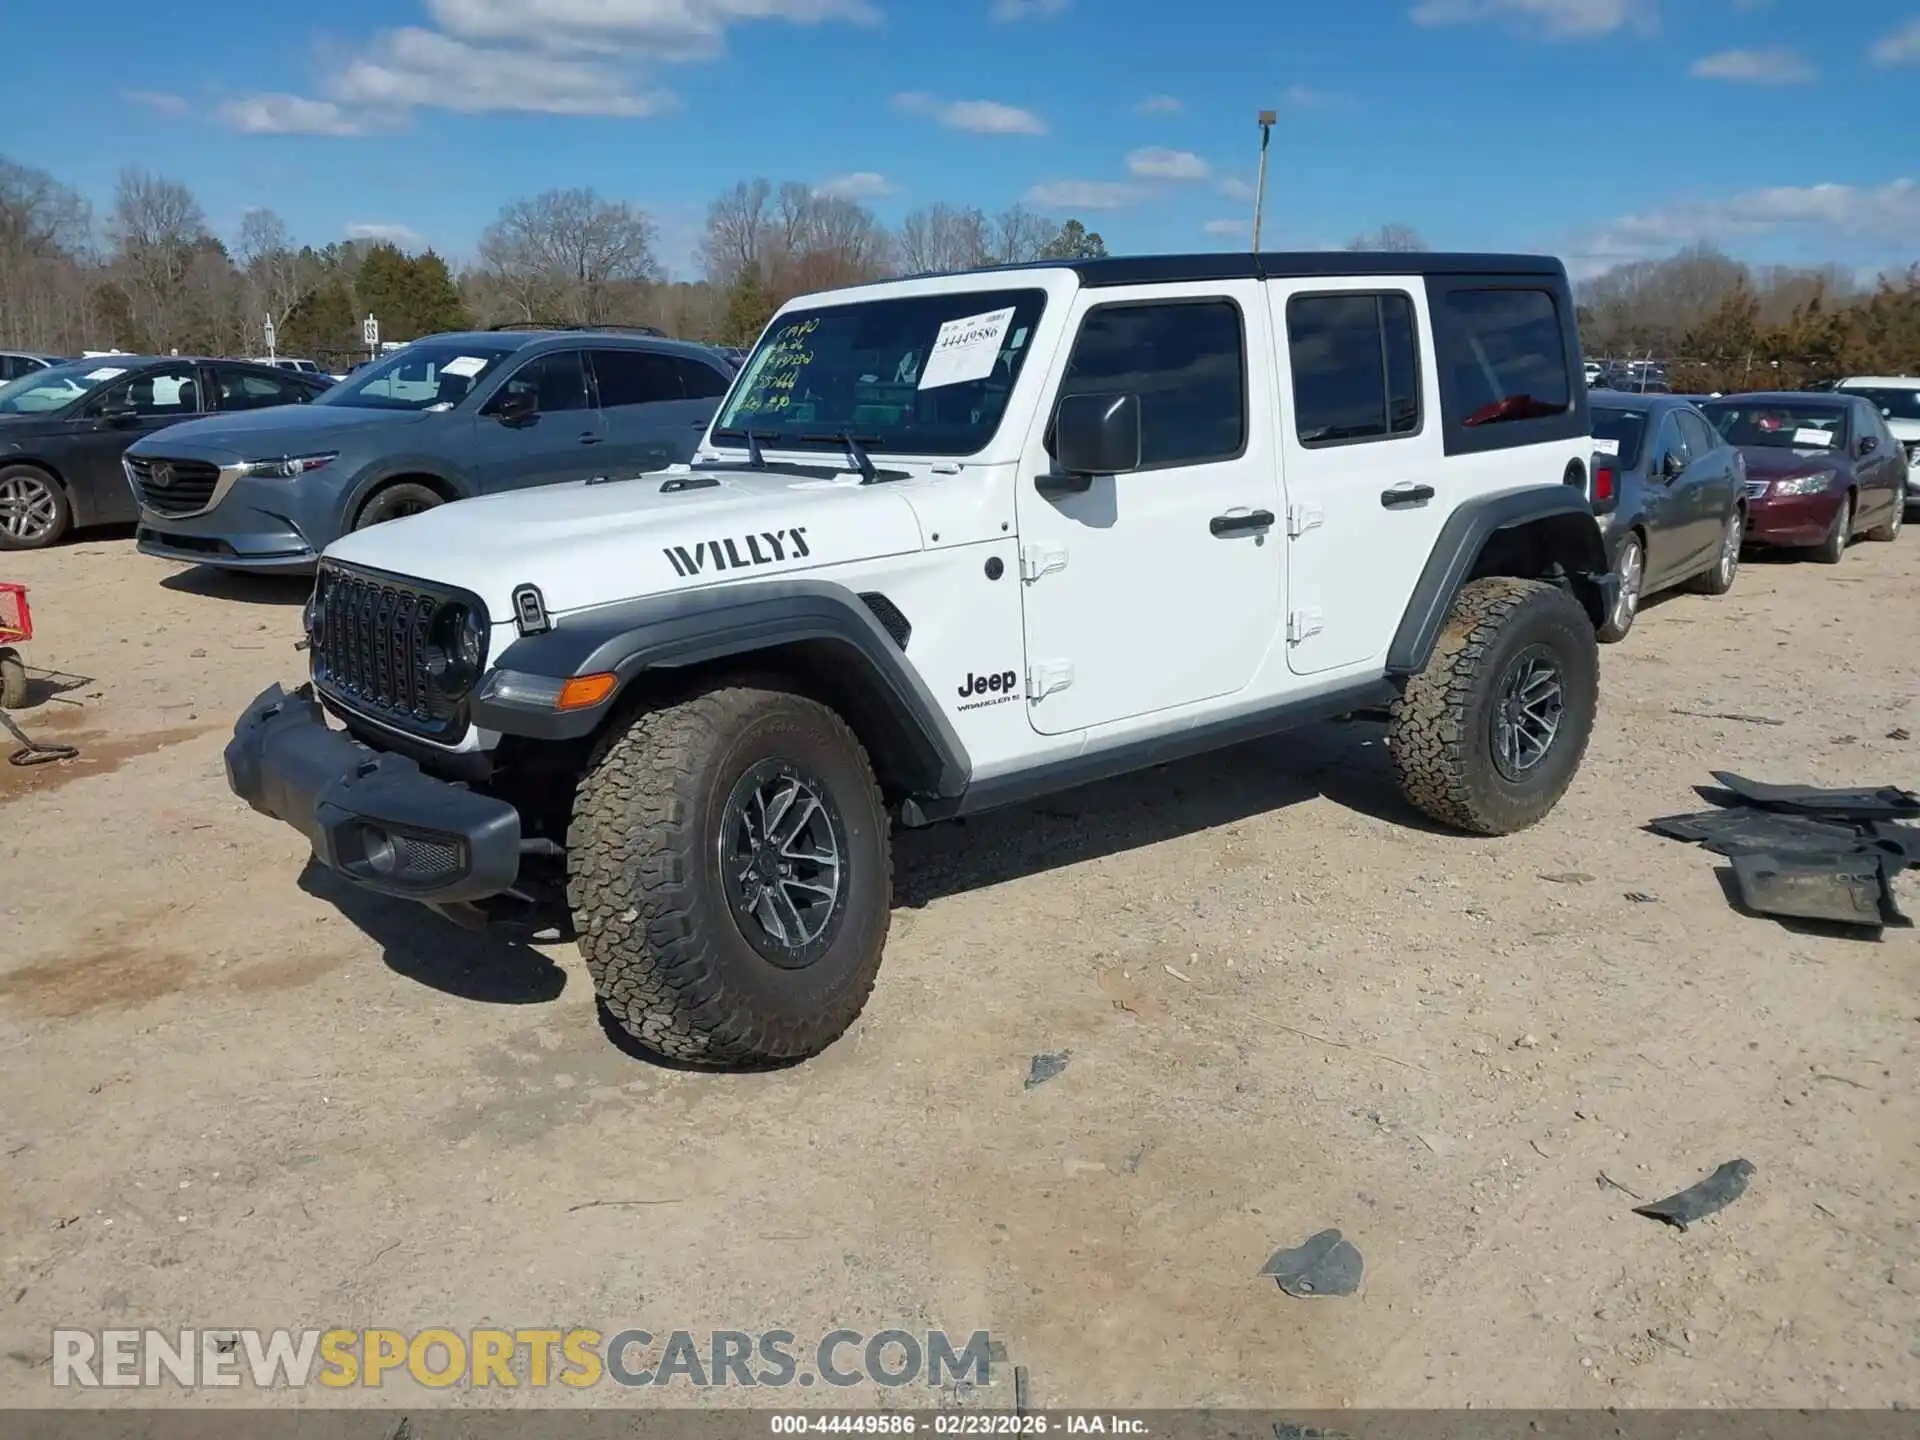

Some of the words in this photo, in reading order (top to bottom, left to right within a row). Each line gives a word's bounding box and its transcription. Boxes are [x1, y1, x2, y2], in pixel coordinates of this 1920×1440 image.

[941, 327, 998, 347] 44449586
[662, 527, 810, 577] WILLYS
[958, 670, 1017, 698] Jeep
[957, 696, 1011, 712] WRANGLER
